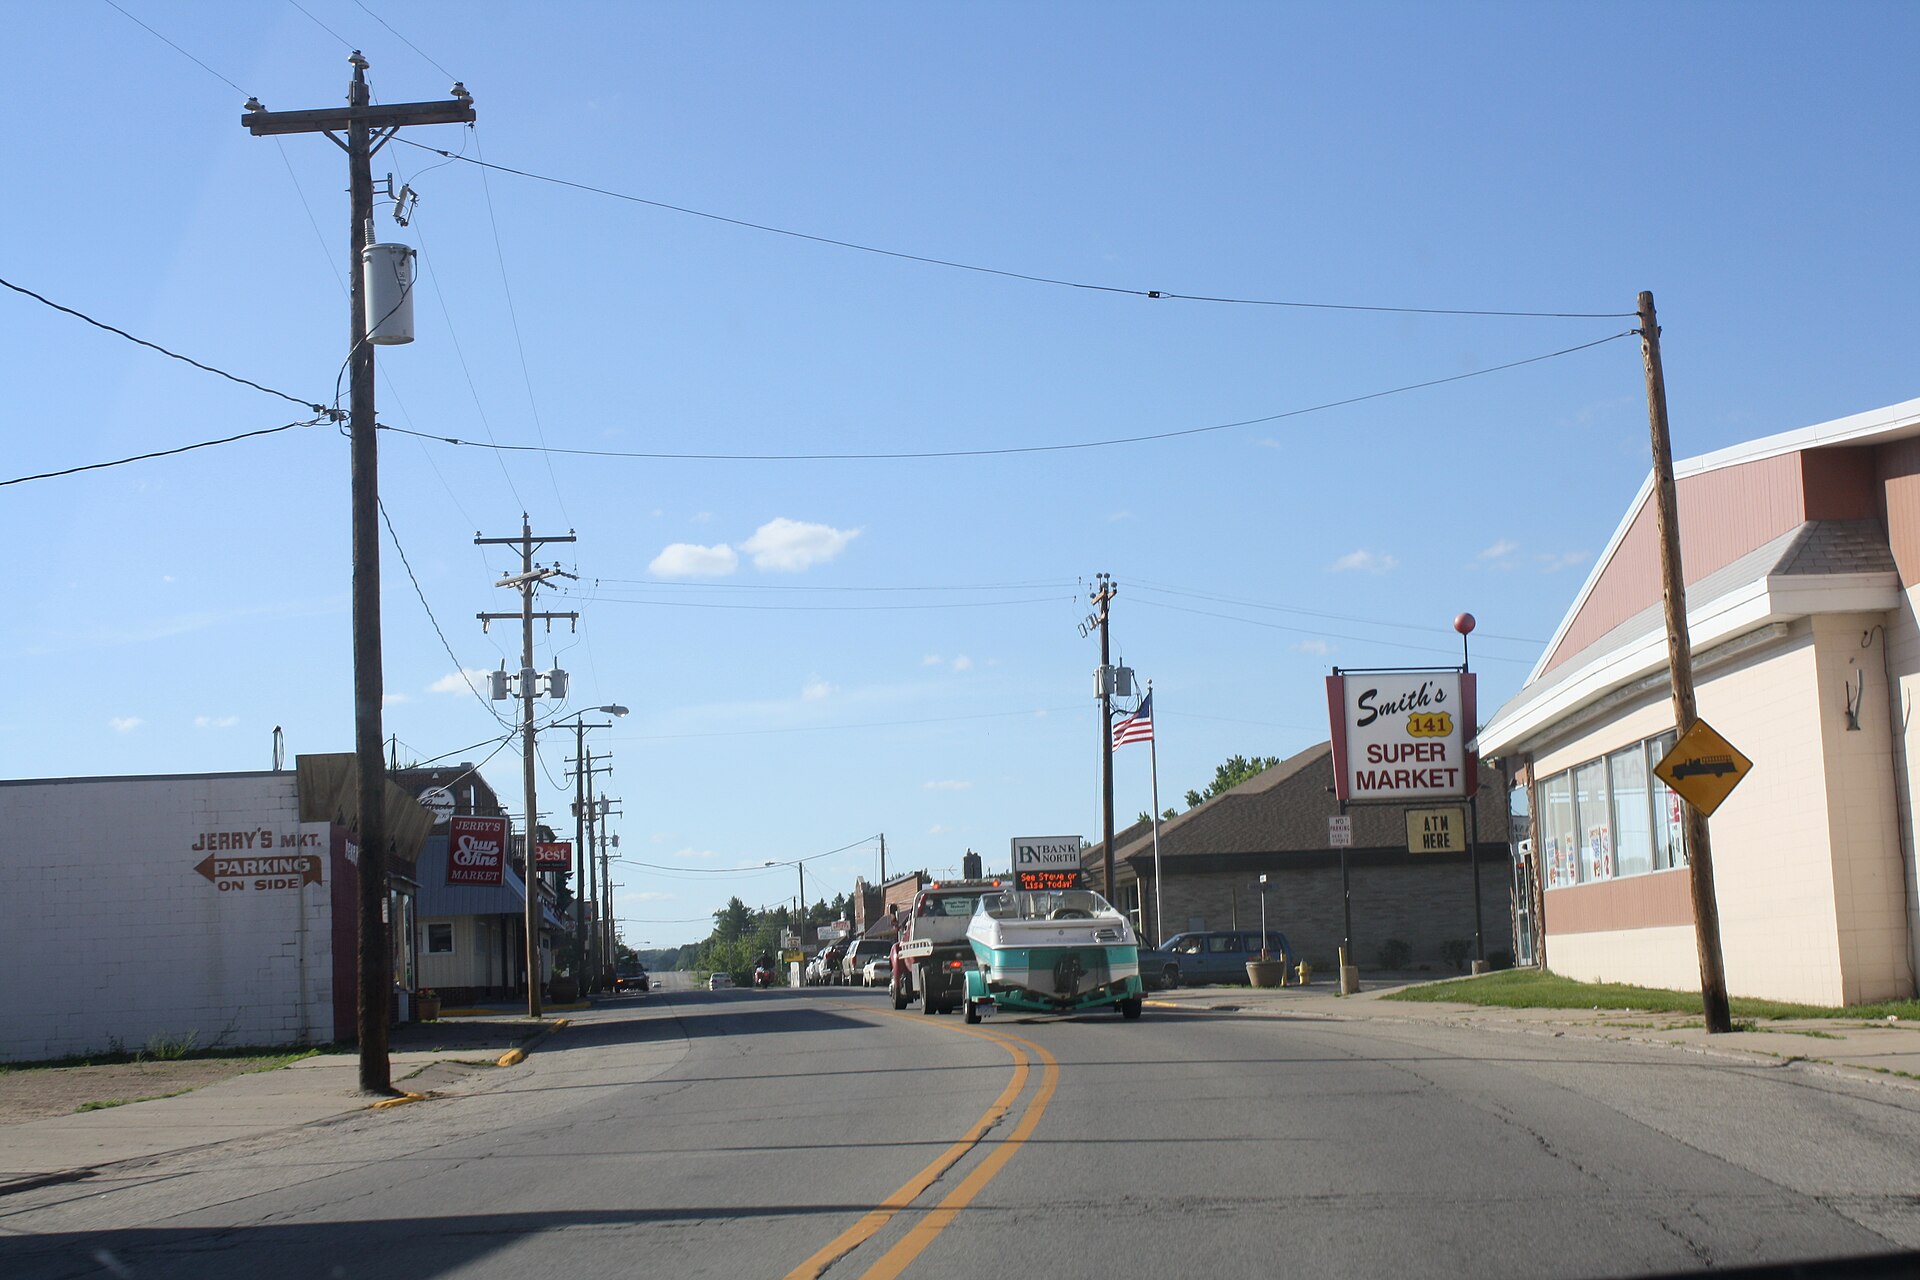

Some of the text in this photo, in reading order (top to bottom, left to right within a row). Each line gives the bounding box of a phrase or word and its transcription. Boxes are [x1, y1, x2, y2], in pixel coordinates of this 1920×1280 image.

[1356, 681, 1448, 727] Smith's
[1412, 717, 1447, 732] 141
[1367, 742, 1446, 764] SUPER
[1356, 768, 1459, 790] MARKET
[455, 820, 501, 832] JERRY'S
[1423, 815, 1449, 831] ATM
[191, 827, 273, 851] JERRY'S
[1422, 832, 1450, 849] HERE
[535, 846, 567, 861] Best
[1042, 844, 1076, 854] BANK
[1042, 853, 1076, 863] NORTH
[214, 857, 311, 876] PARKING
[451, 871, 499, 881] MARKET
[1021, 872, 1036, 882] See
[218, 878, 299, 891] ON SIDE
